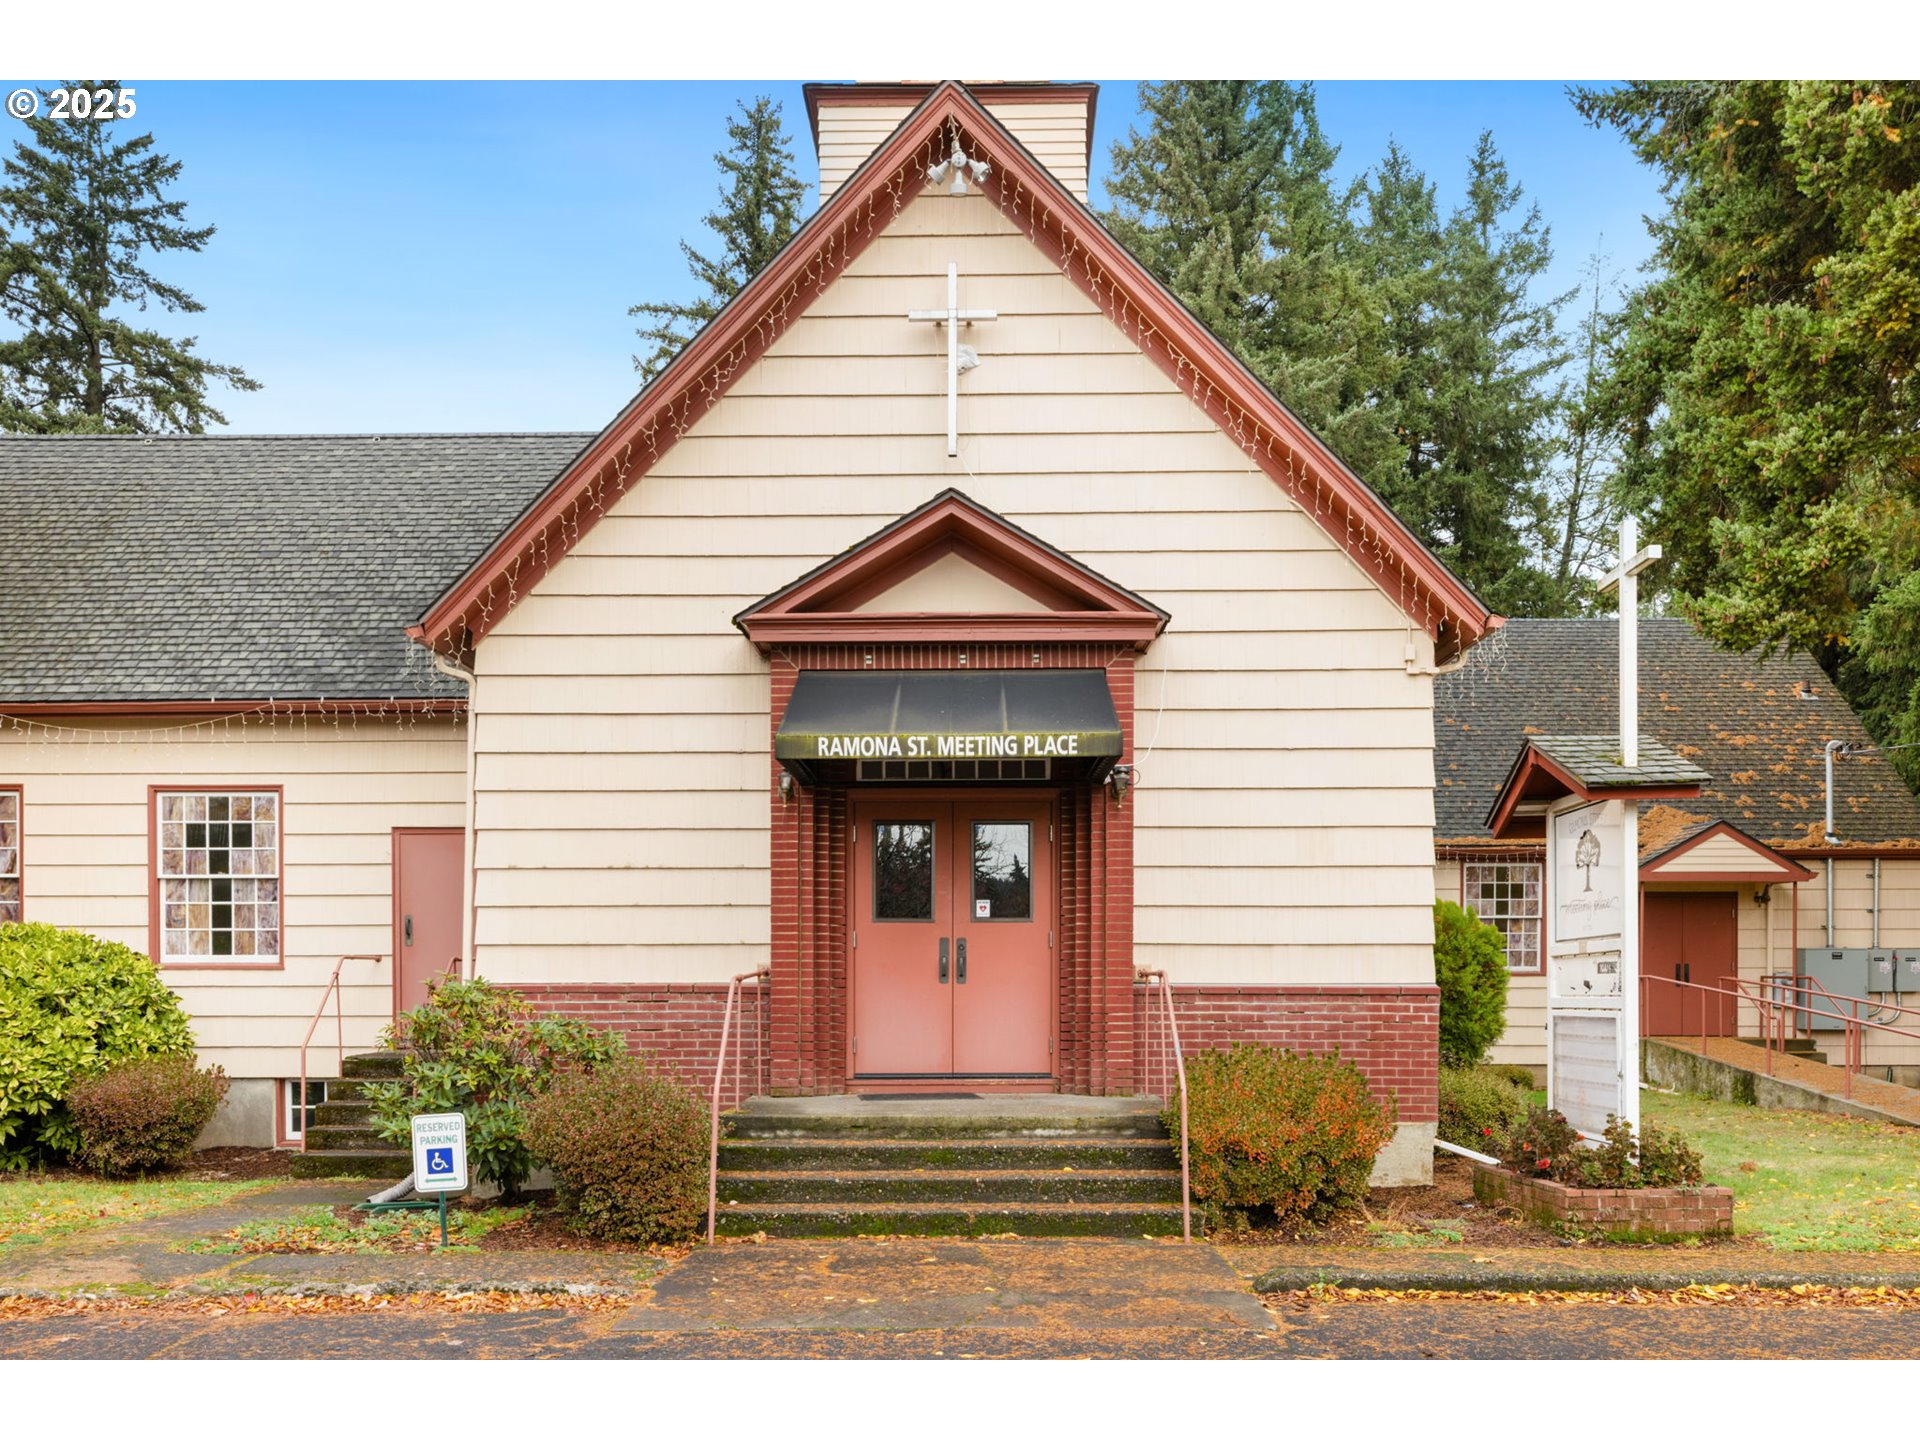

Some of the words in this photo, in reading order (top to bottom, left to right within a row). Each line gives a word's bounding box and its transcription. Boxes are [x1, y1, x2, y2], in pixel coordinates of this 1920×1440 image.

[817, 736, 902, 756] RAMONA
[907, 736, 931, 756] ST.
[937, 736, 1018, 756] MEETING
[1023, 735, 1078, 755] PLACE
[416, 1121, 460, 1133] RESERVED
[420, 1134, 458, 1145] PARKING
